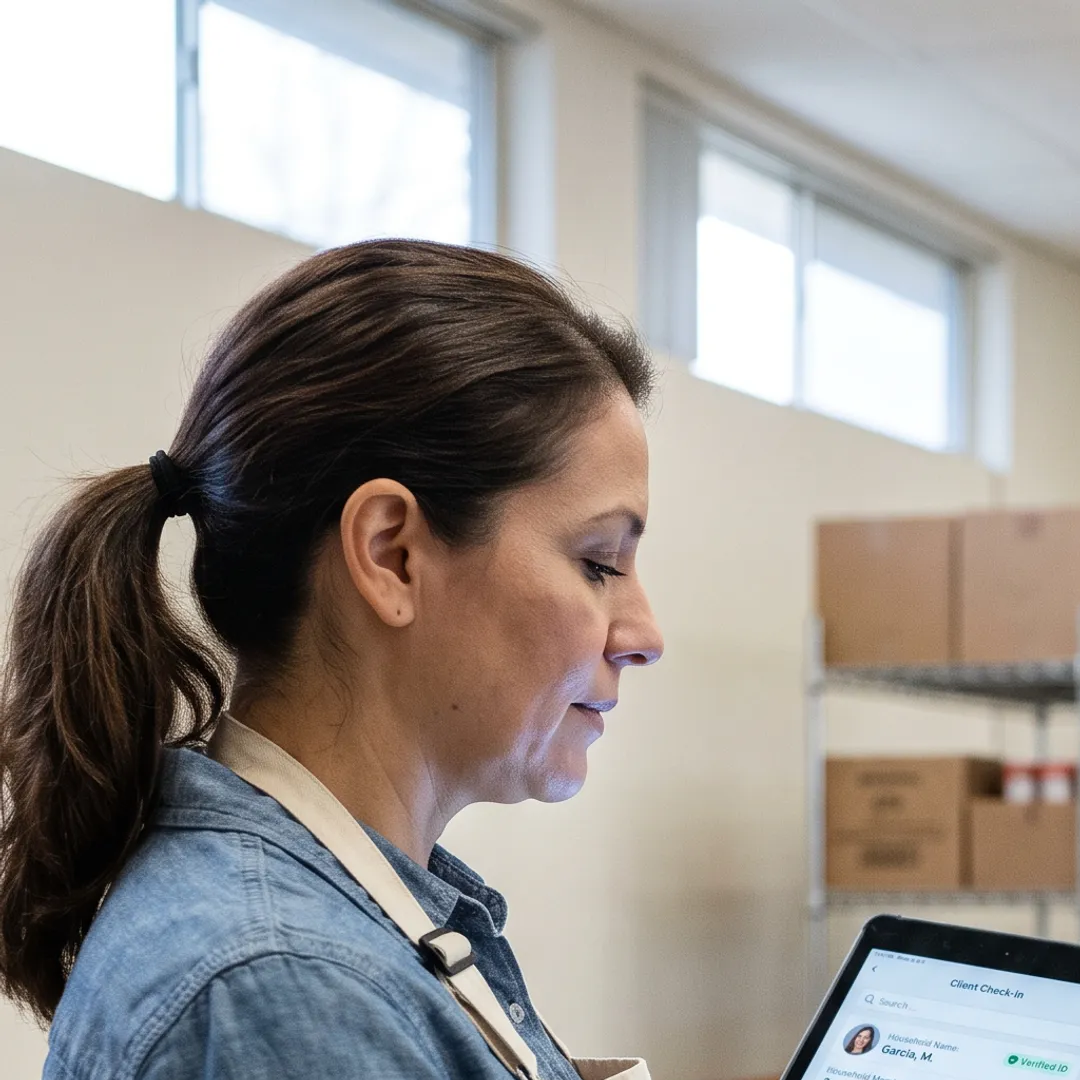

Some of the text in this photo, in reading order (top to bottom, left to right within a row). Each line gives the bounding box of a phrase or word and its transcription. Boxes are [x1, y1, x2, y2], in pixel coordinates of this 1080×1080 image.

[950, 979, 1024, 999] Client Check-in
[881, 1044, 933, 1063] Garcia, M.
[933, 1039, 960, 1053] Name:
[1020, 1057, 1069, 1073] Verified ID
